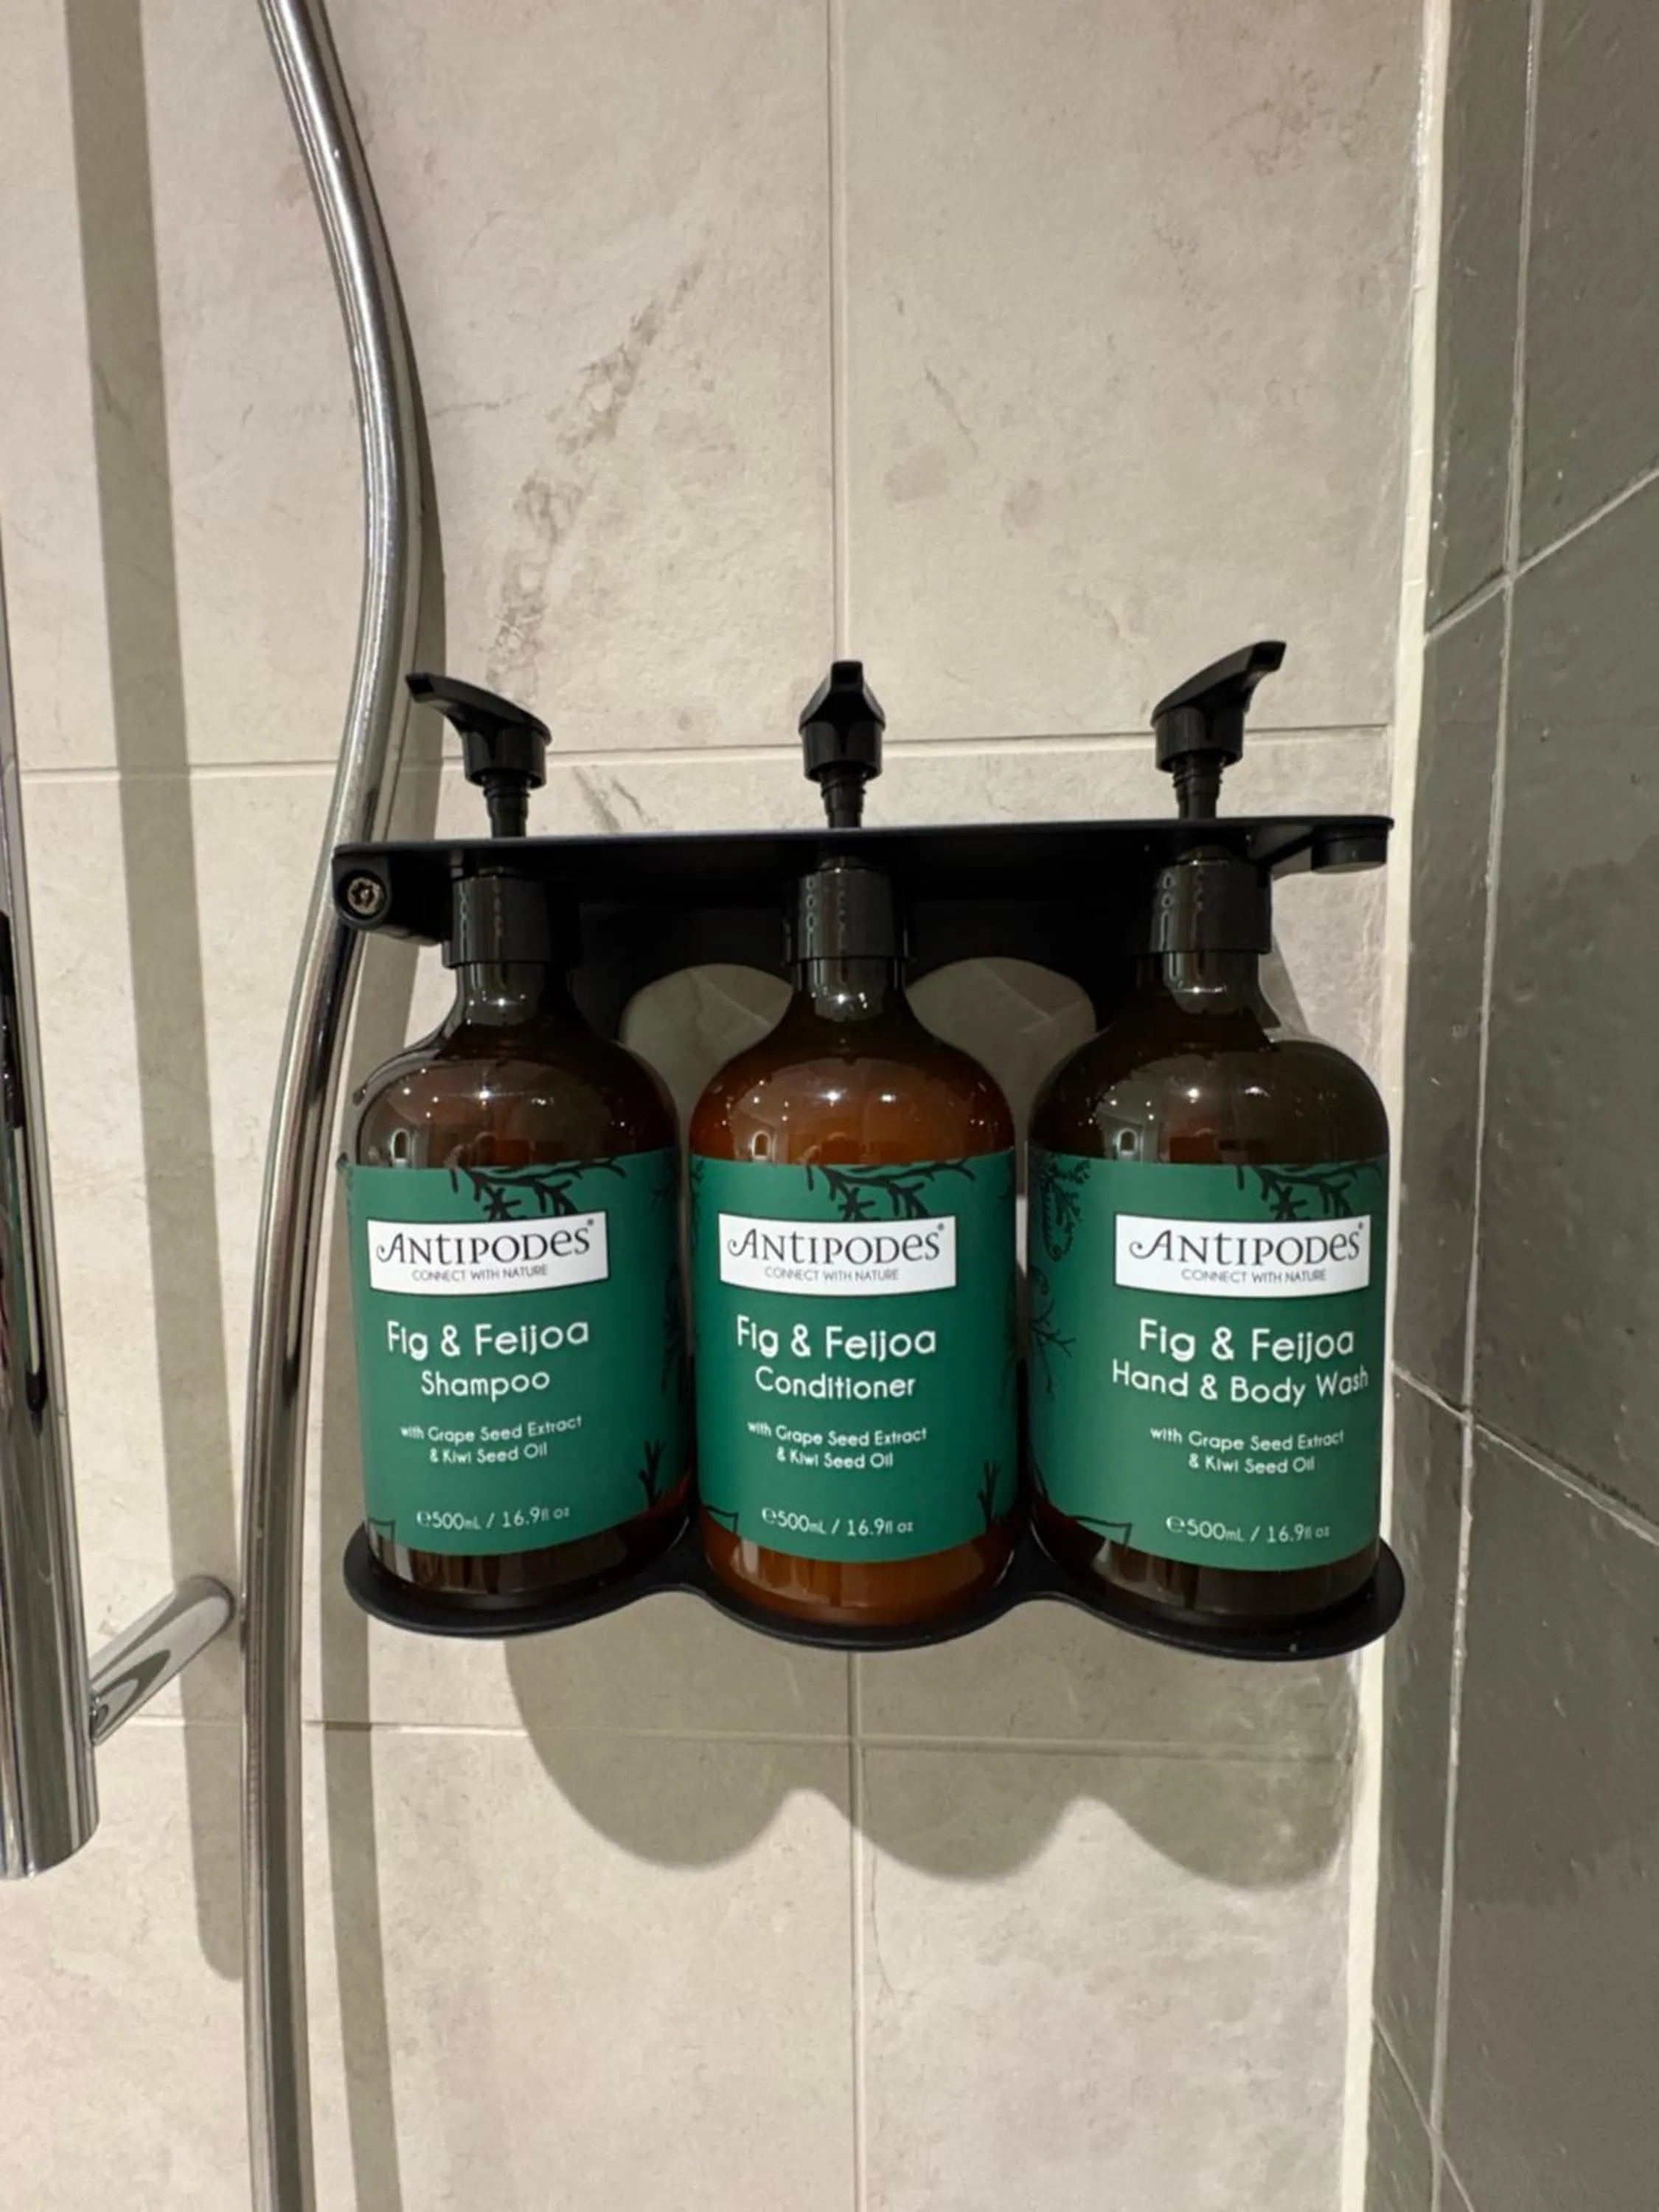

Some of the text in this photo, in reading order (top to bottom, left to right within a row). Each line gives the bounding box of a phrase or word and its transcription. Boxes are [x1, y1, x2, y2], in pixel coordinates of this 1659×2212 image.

[413, 1265, 548, 1281] CONNECT WITH NATURE
[765, 1267, 899, 1281] CONNECT WITH NATURE
[1181, 1268, 1327, 1284] CONNECT WITH NATURE
[388, 1321, 589, 1360] Fig & Feijoa
[737, 1315, 937, 1362] Fig & Feijoa
[1140, 1318, 1354, 1364] Fig & Feijoa
[421, 1370, 550, 1402] Shampoo
[755, 1366, 916, 1401] Conditioner
[1113, 1359, 1368, 1407] Hand & Body Wash
[401, 1415, 582, 1444] with Grape Seed Extract
[748, 1420, 928, 1446] with Grape Seed Extract
[1150, 1426, 1344, 1453] with Grape Seed Extract
[430, 1442, 548, 1464] & Kiwi Seed Oil
[777, 1447, 894, 1469] & Kiwi Seed Oil
[1189, 1453, 1315, 1473] & Kiwi Seed Oil
[486, 1512, 495, 1528] /
[831, 1517, 841, 1534] /
[1250, 1525, 1260, 1542] /
